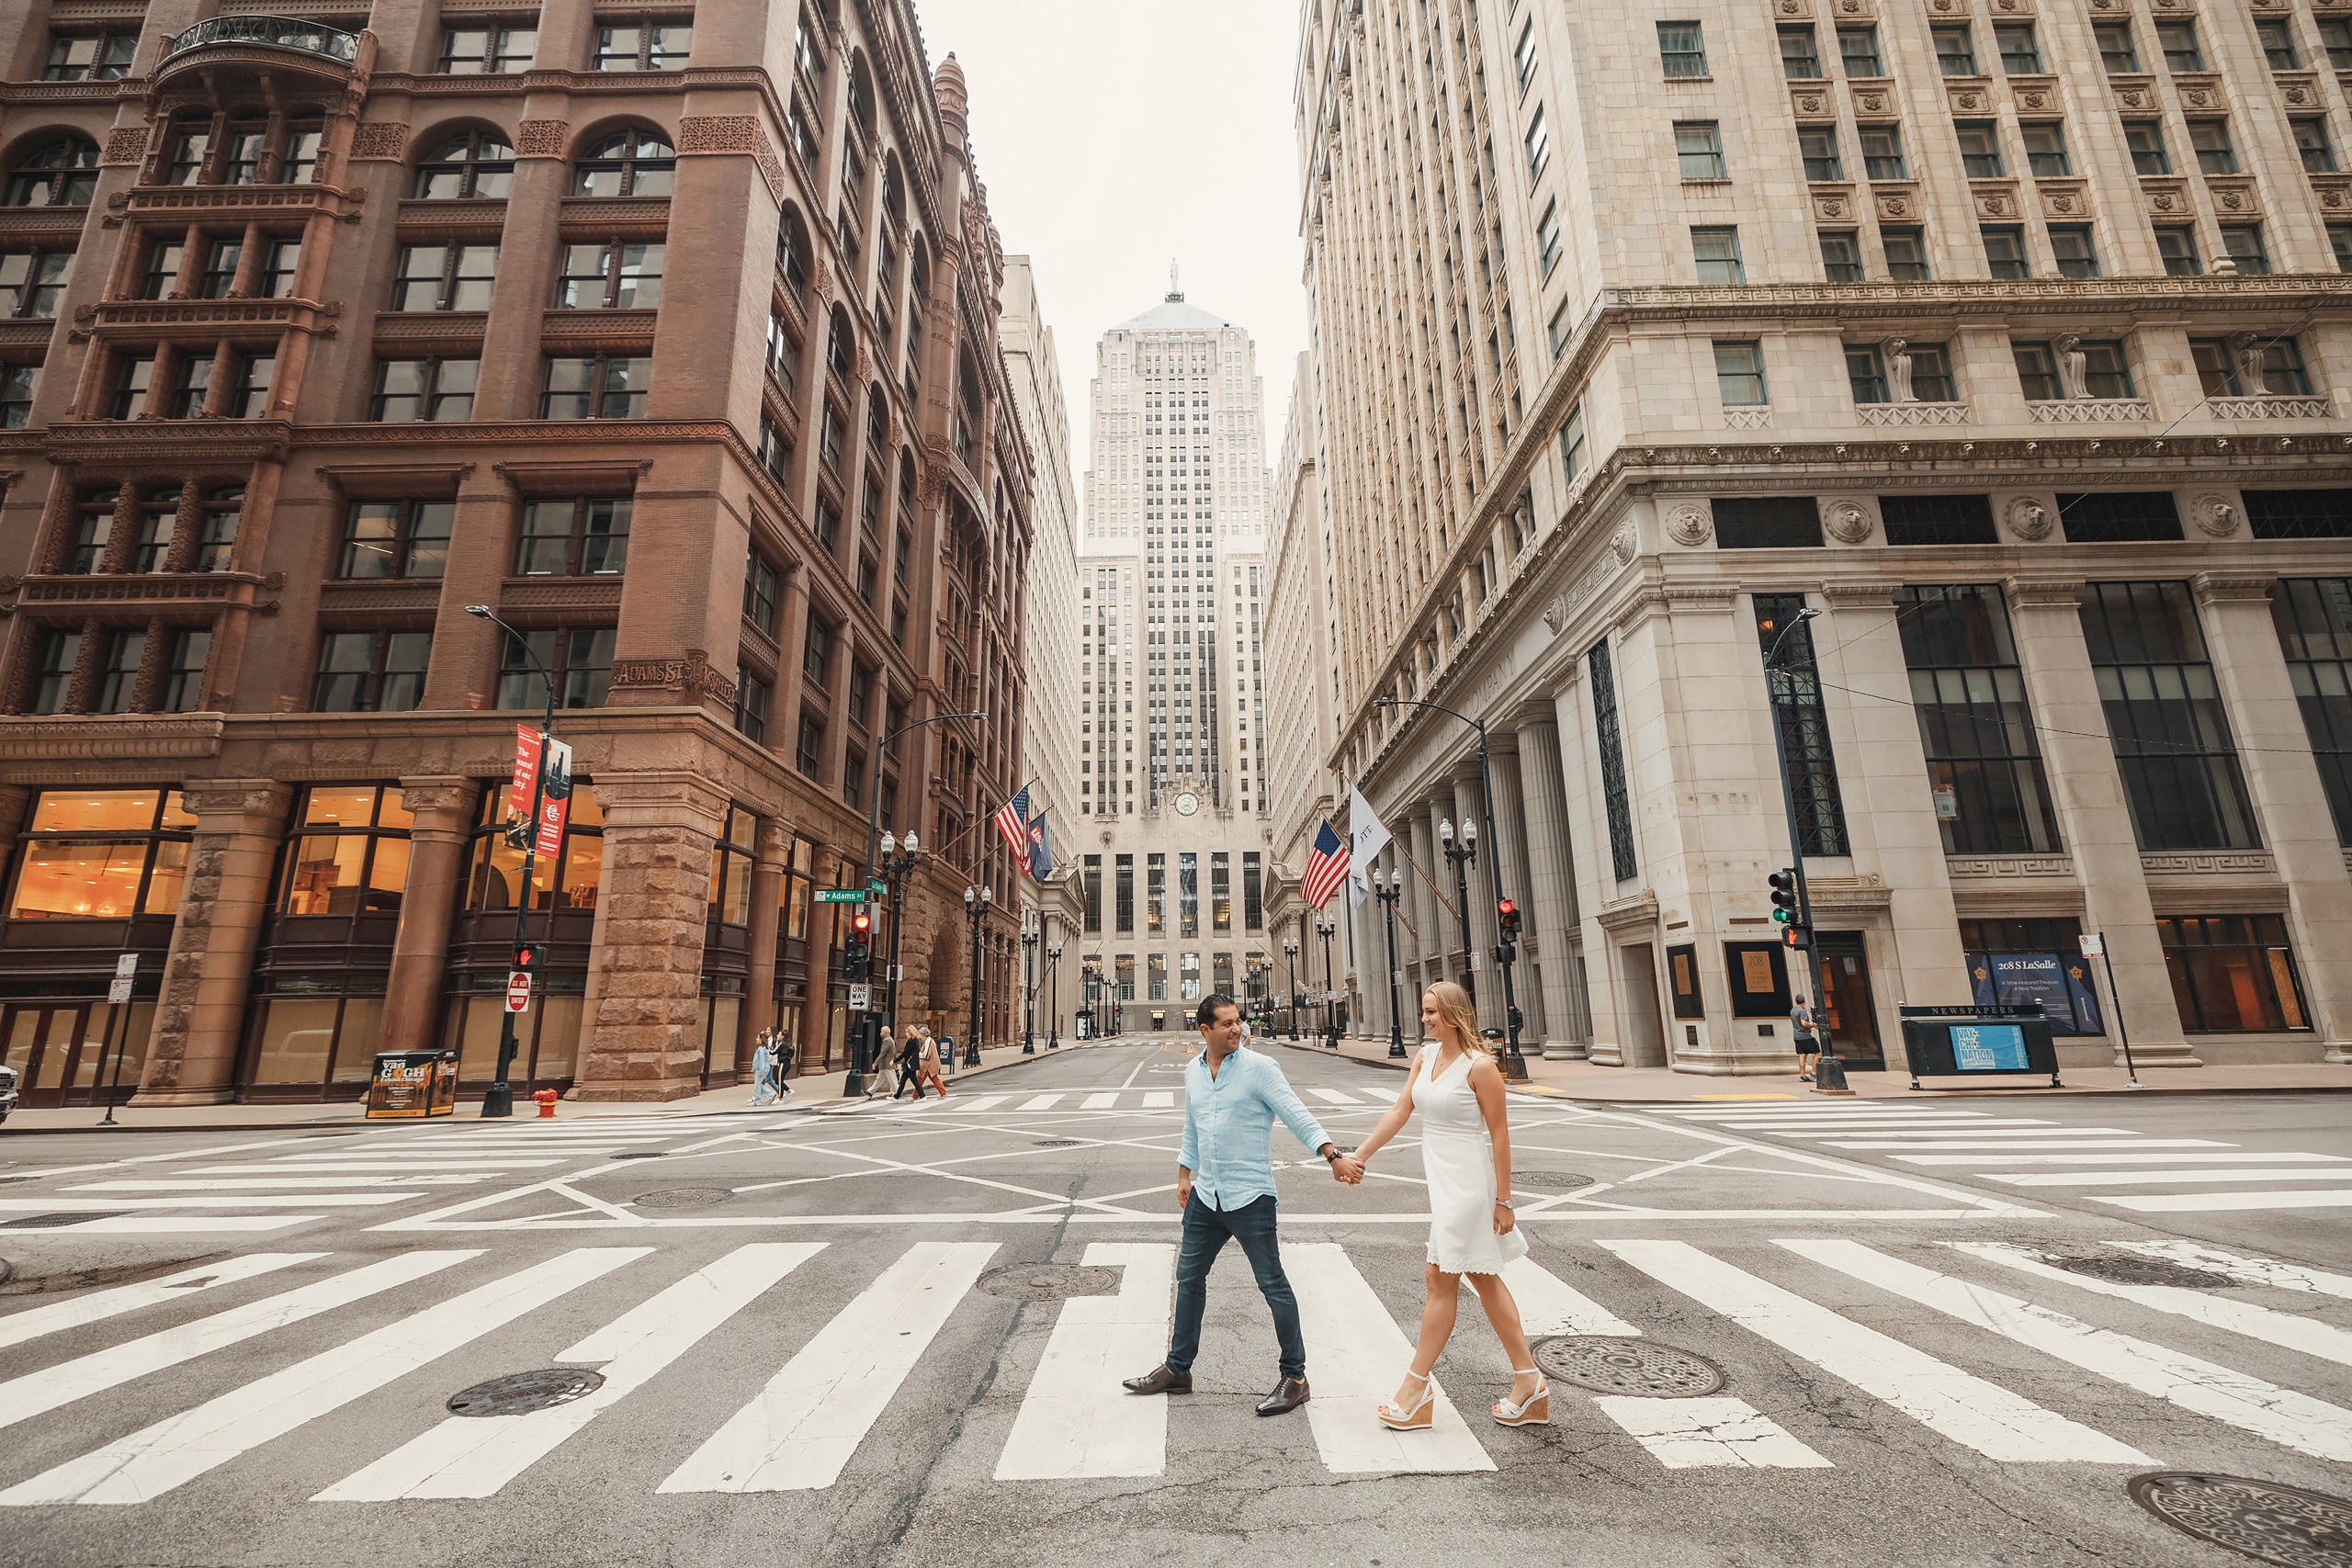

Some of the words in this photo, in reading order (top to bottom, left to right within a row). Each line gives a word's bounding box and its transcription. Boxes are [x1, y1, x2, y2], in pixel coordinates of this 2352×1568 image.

[1418, 744, 1431, 767] AND
[1436, 712, 1459, 751] TRUST
[1464, 648, 1515, 717] COMPANY
[518, 746, 529, 758] The
[516, 759, 533, 770] sound
[514, 779, 526, 790] city.
[1123, 831, 1168, 840] CHICAGO
[1172, 830, 1203, 839] BOARD
[1225, 829, 1255, 838] TRADE
[1748, 955, 1764, 967] 208
[1998, 961, 2014, 970] 208
[2015, 961, 2021, 970] S
[2022, 959, 2056, 969] LaSalle
[1931, 1006, 2014, 1015] NEWSPAPERS
[1957, 1029, 1975, 1039] VAX
[1962, 1050, 1993, 1060] NATION
